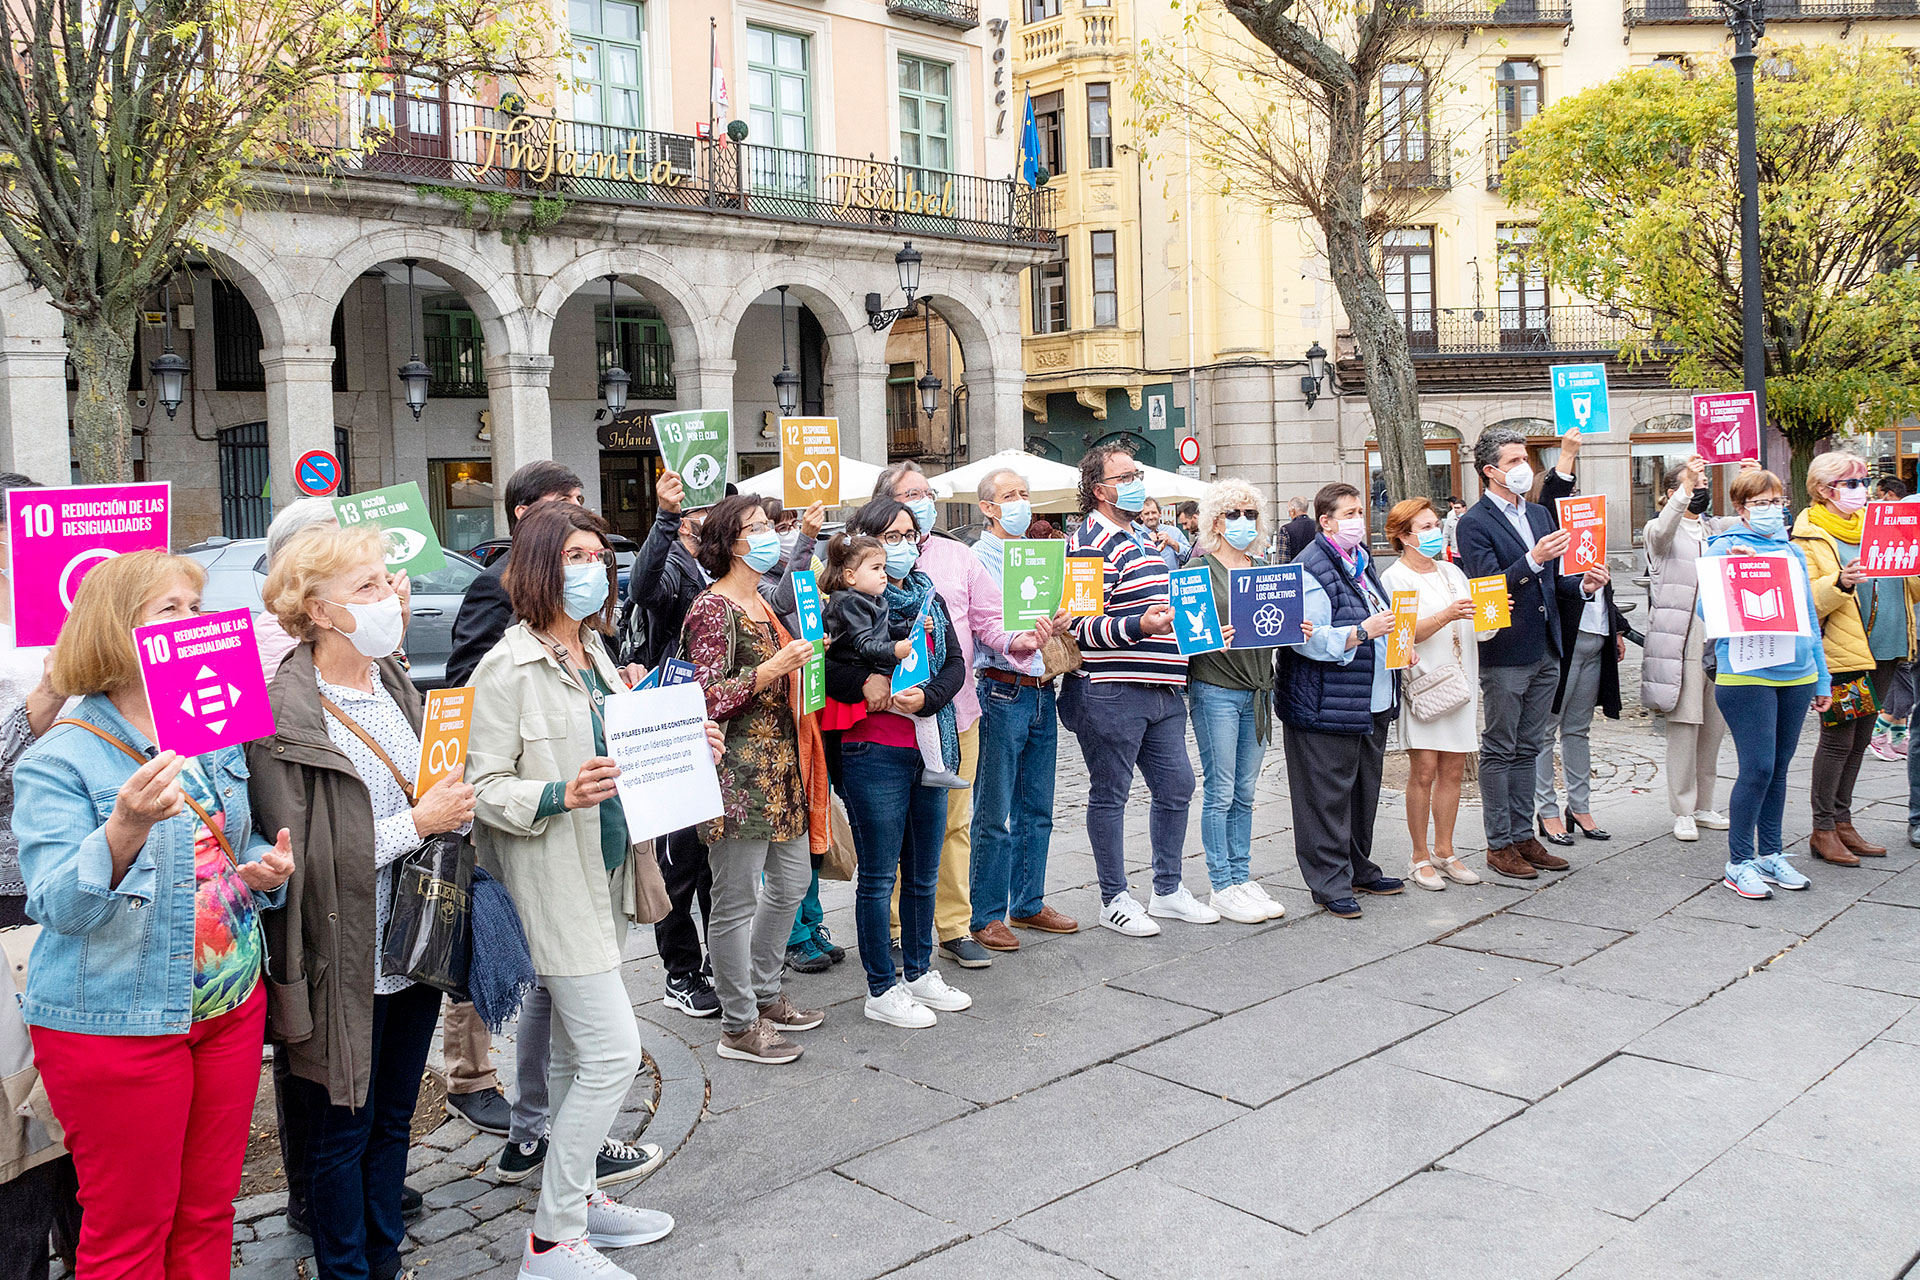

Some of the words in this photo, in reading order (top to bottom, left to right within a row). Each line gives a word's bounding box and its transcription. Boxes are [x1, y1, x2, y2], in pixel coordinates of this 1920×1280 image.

[986, 18, 1008, 135] Hotel
[455, 116, 681, 187] Infanta
[823, 163, 956, 217] Isabel
[1558, 373, 1565, 387] 6
[1700, 402, 1708, 417] 8
[609, 427, 651, 449] Infanta
[664, 423, 683, 443] 13
[687, 432, 699, 442] POR
[786, 426, 800, 446] 12
[61, 499, 127, 518] REDUCCIÓN
[129, 500, 143, 514] DE
[145, 498, 164, 513] LAS
[361, 495, 387, 510] ACCIÓN
[364, 510, 380, 520] POR
[380, 506, 388, 517] EL
[387, 502, 410, 515] CLIMA
[1885, 506, 1893, 514] FIN
[20, 503, 54, 537] 10
[339, 502, 360, 524] 13
[1564, 504, 1571, 521] 9
[1875, 505, 1881, 525] 1
[1884, 516, 1890, 525] DE
[1890, 516, 1897, 525] LA
[62, 517, 152, 536] DESIGUALDADES
[1009, 547, 1022, 567] 15
[1740, 561, 1770, 570] EDUCACIÓN
[1256, 573, 1281, 583] ALIANZAS
[1282, 572, 1296, 581] PARA
[1727, 563, 1736, 578] 4
[1237, 576, 1251, 593] 17
[1256, 582, 1277, 592] LOGRAR
[1472, 583, 1476, 594] 7
[1256, 592, 1267, 601] LOS
[1267, 589, 1296, 600] OBJETIVOS
[1395, 598, 1399, 613] 7
[173, 621, 220, 643] REDUCCIÓN
[220, 620, 233, 633] DE
[233, 618, 249, 631] LAS
[142, 634, 171, 665] 10
[176, 635, 242, 659] DESIGUALDADES
[430, 698, 441, 720] 12
[610, 731, 621, 741] LOS
[621, 728, 641, 739] PILARES
[641, 725, 654, 734] PARA
[654, 724, 661, 732] LA
[625, 744, 642, 756] Ejercer
[643, 743, 650, 751] un
[650, 738, 673, 748] liderazgo
[673, 729, 704, 744] internacional
[635, 759, 641, 768] el
[641, 753, 672, 768] compromiso
[672, 751, 682, 760] con
[682, 749, 691, 758] una
[622, 776, 641, 788] Agenda
[641, 771, 655, 783] 2030
